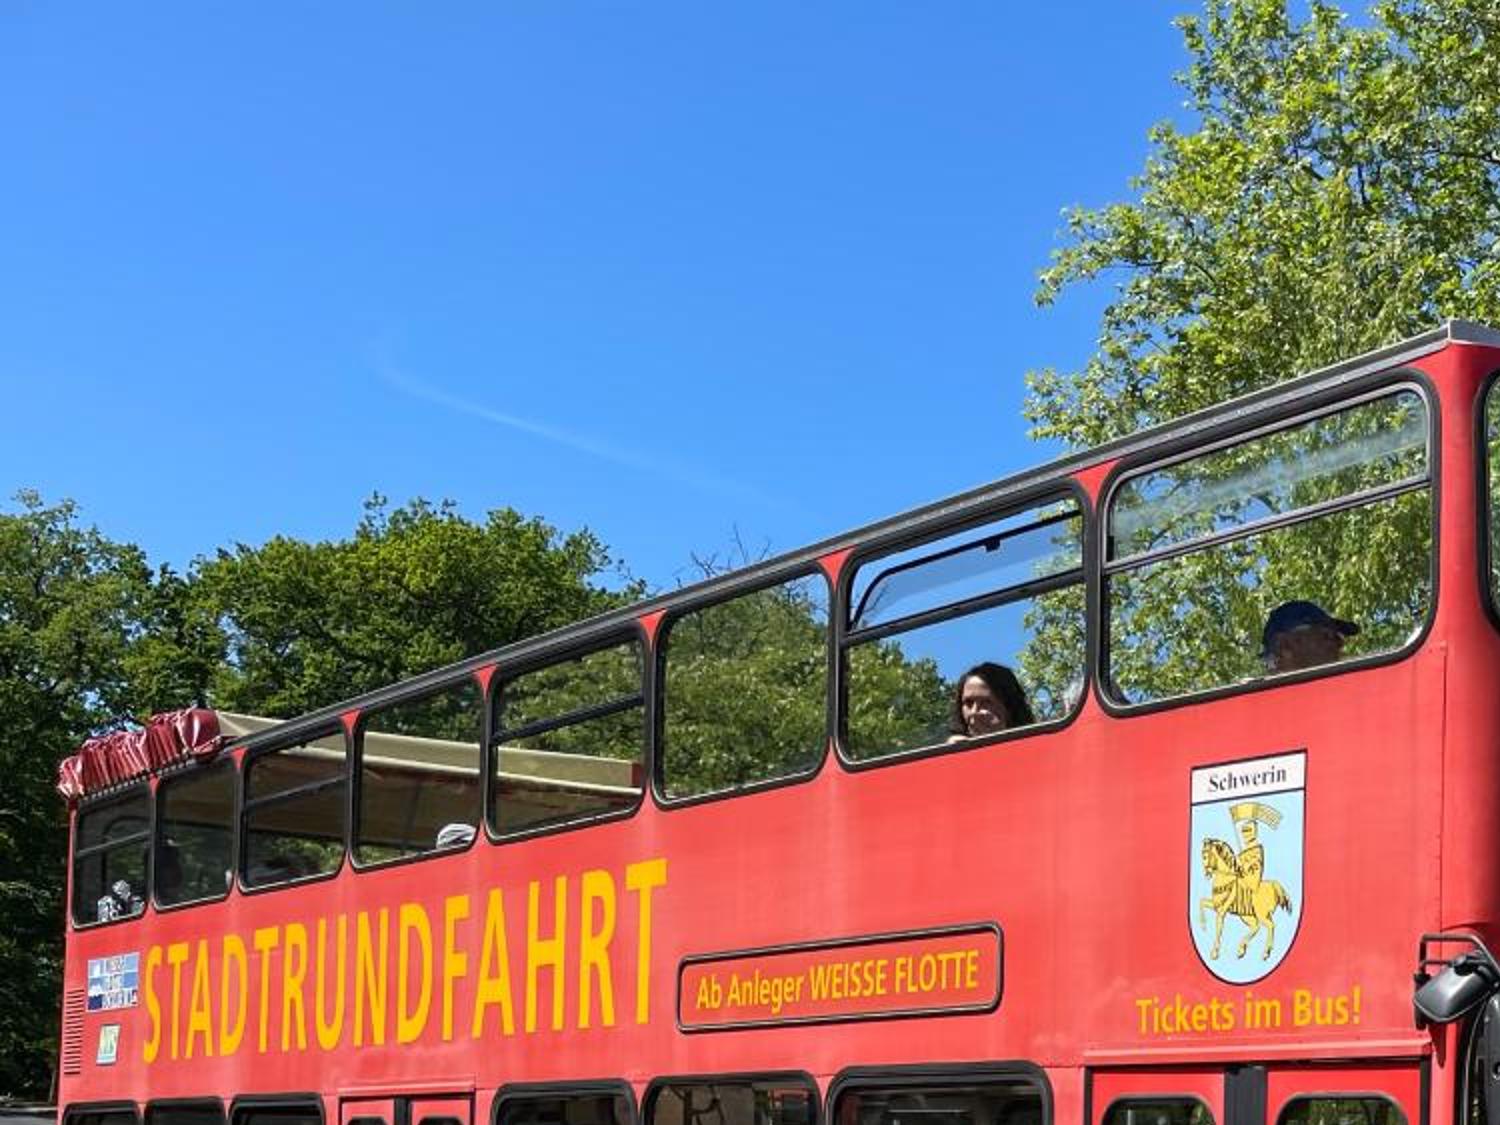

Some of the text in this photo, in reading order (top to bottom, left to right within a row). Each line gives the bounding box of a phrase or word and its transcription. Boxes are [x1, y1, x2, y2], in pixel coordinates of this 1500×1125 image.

[1208, 765, 1287, 792] Schwerin
[143, 857, 668, 1063] STADTRUNDFAHRT
[696, 950, 979, 1014] Ab Anleger WEISSE FLOTTE
[1136, 985, 1362, 1034] Tickets im Bus!
